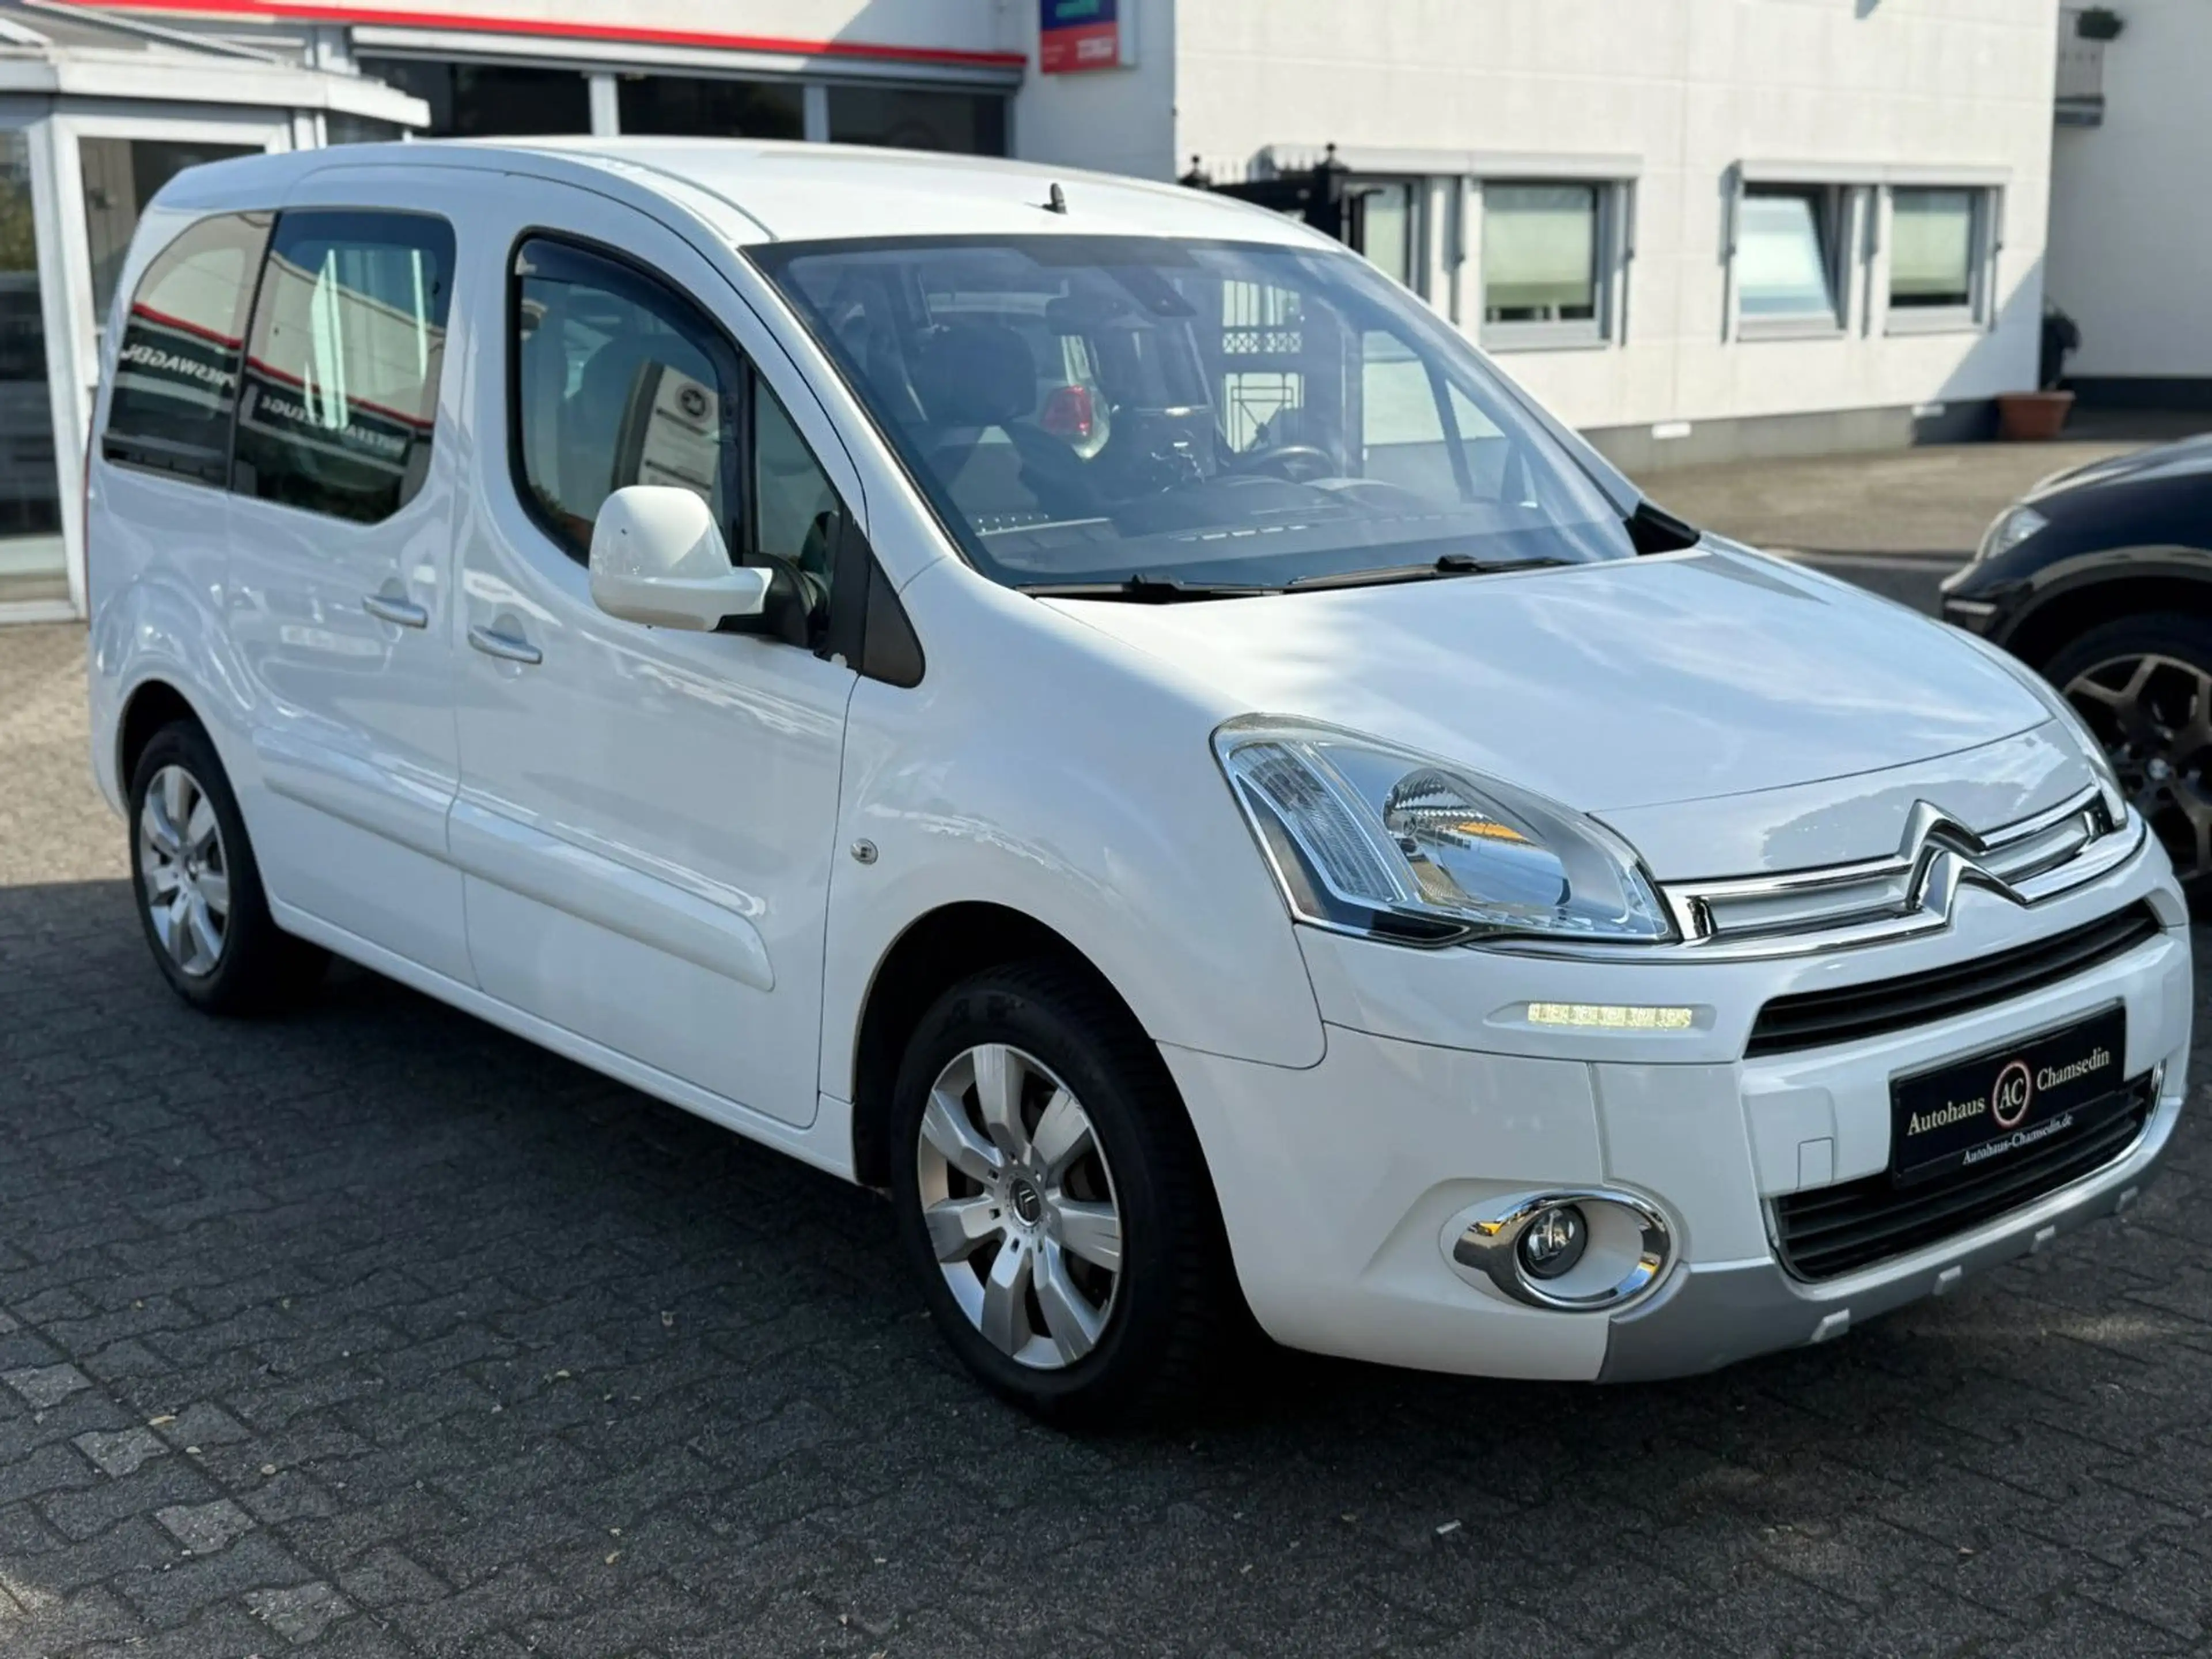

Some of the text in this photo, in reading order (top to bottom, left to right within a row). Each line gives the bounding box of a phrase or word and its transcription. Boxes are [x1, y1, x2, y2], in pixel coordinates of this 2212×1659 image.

[1907, 1046, 2110, 1136] Autohaus AC Chamsedin
[1962, 1113, 2074, 1166] Autohaus-Chamsedin.de
